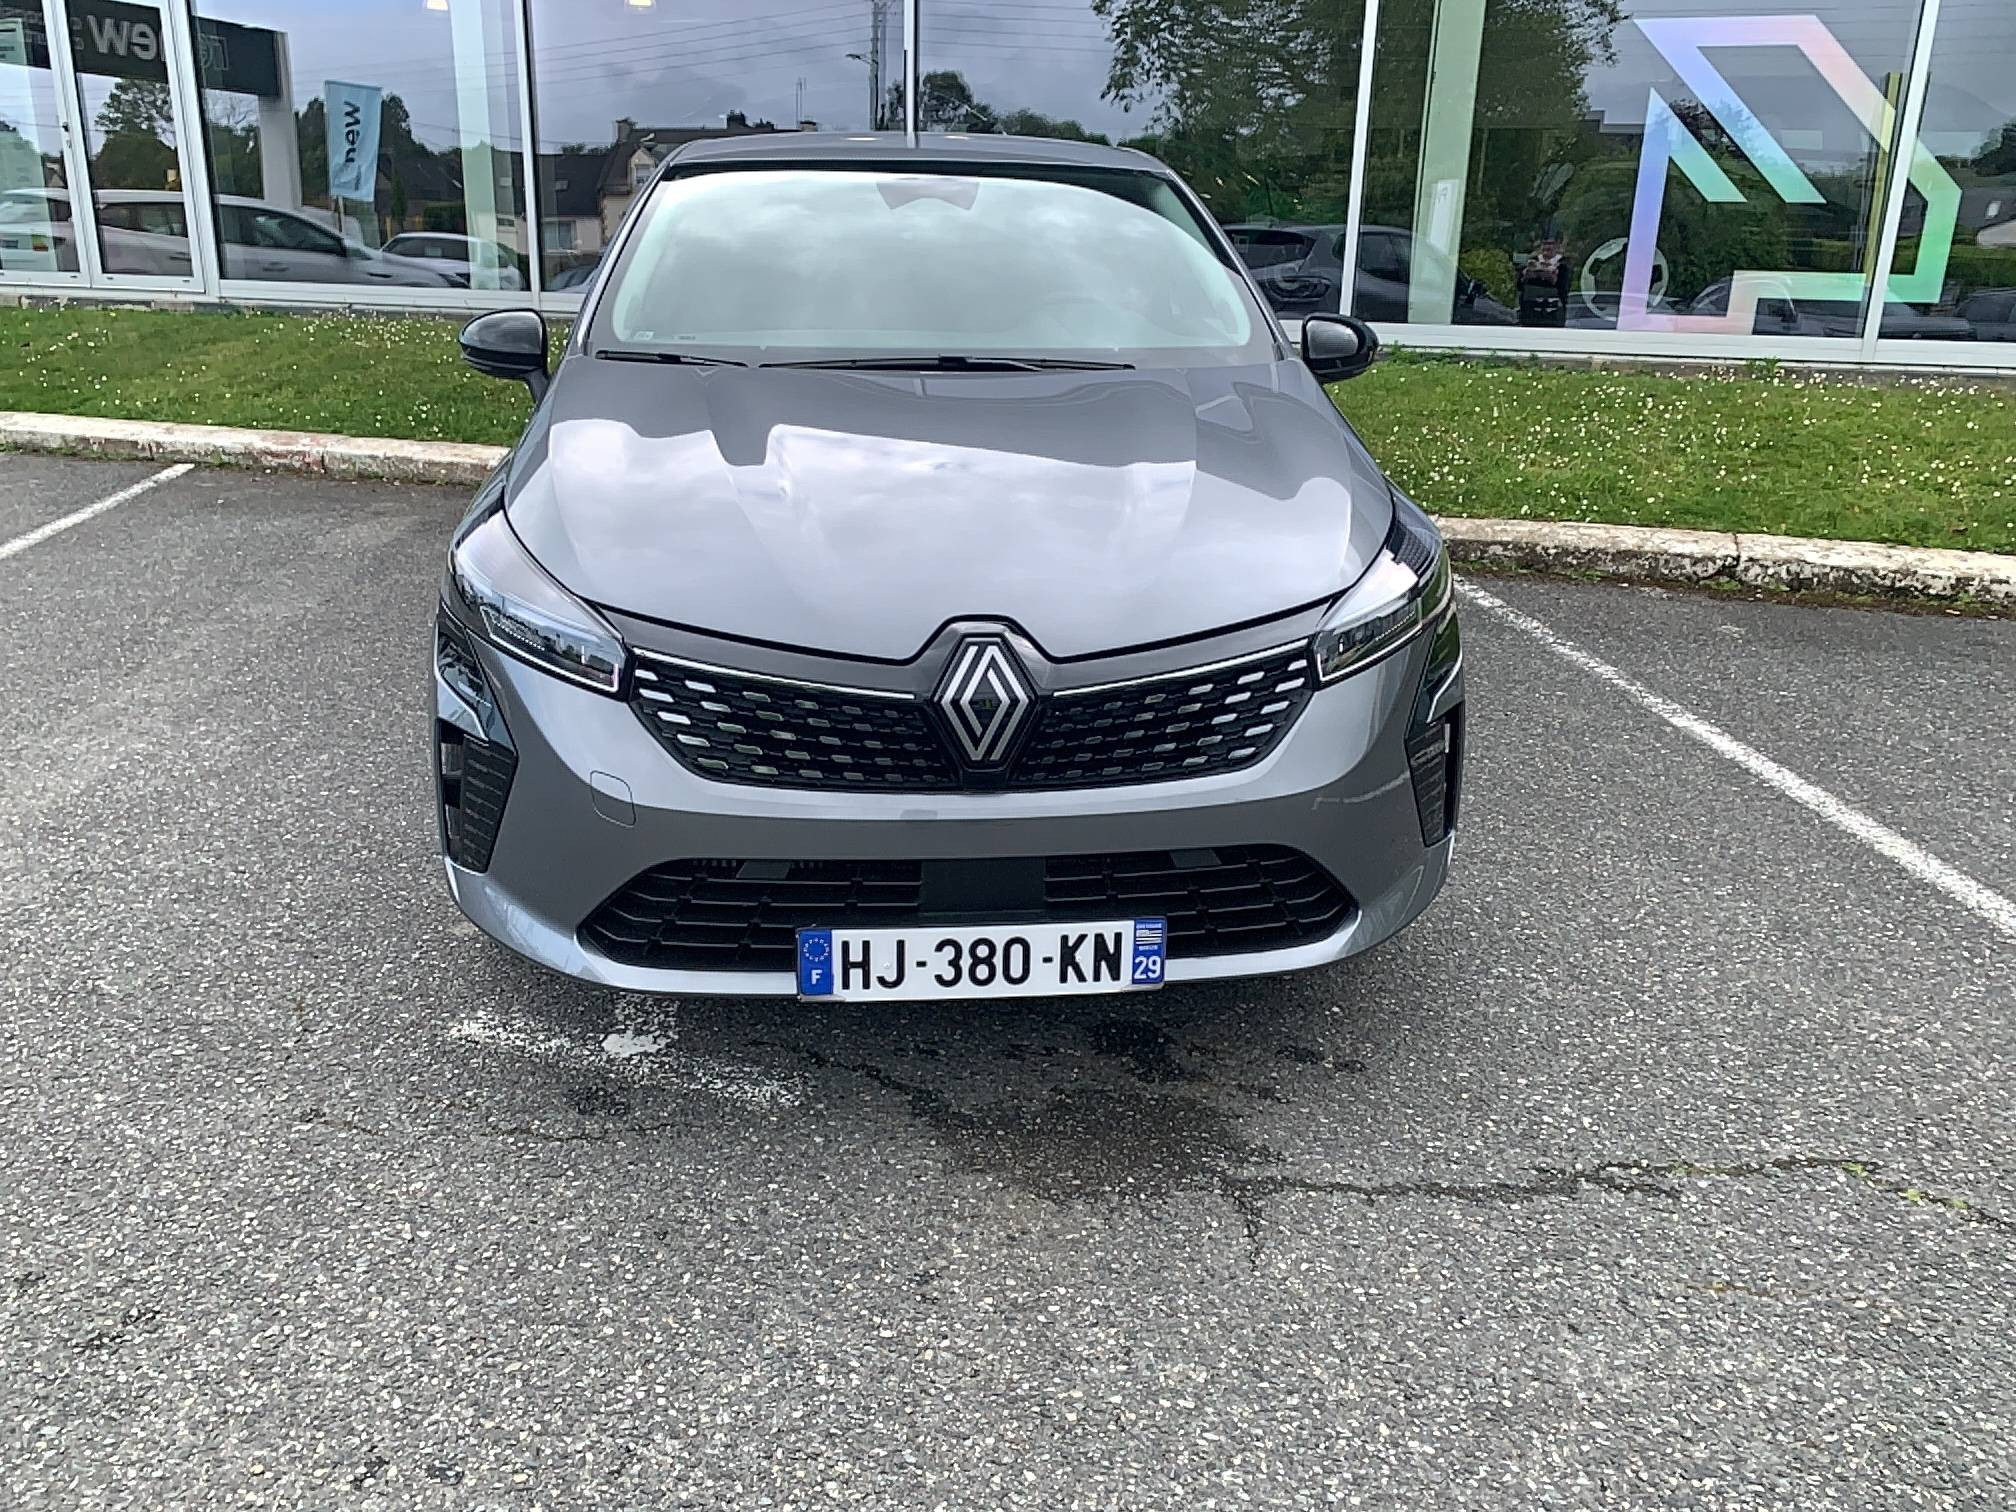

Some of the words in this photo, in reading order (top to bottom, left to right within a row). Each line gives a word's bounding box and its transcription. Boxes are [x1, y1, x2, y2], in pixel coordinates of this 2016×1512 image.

[841, 932, 1123, 990] HJ-380-KN
[1134, 955, 1161, 979] 29
[811, 969, 823, 985] F
